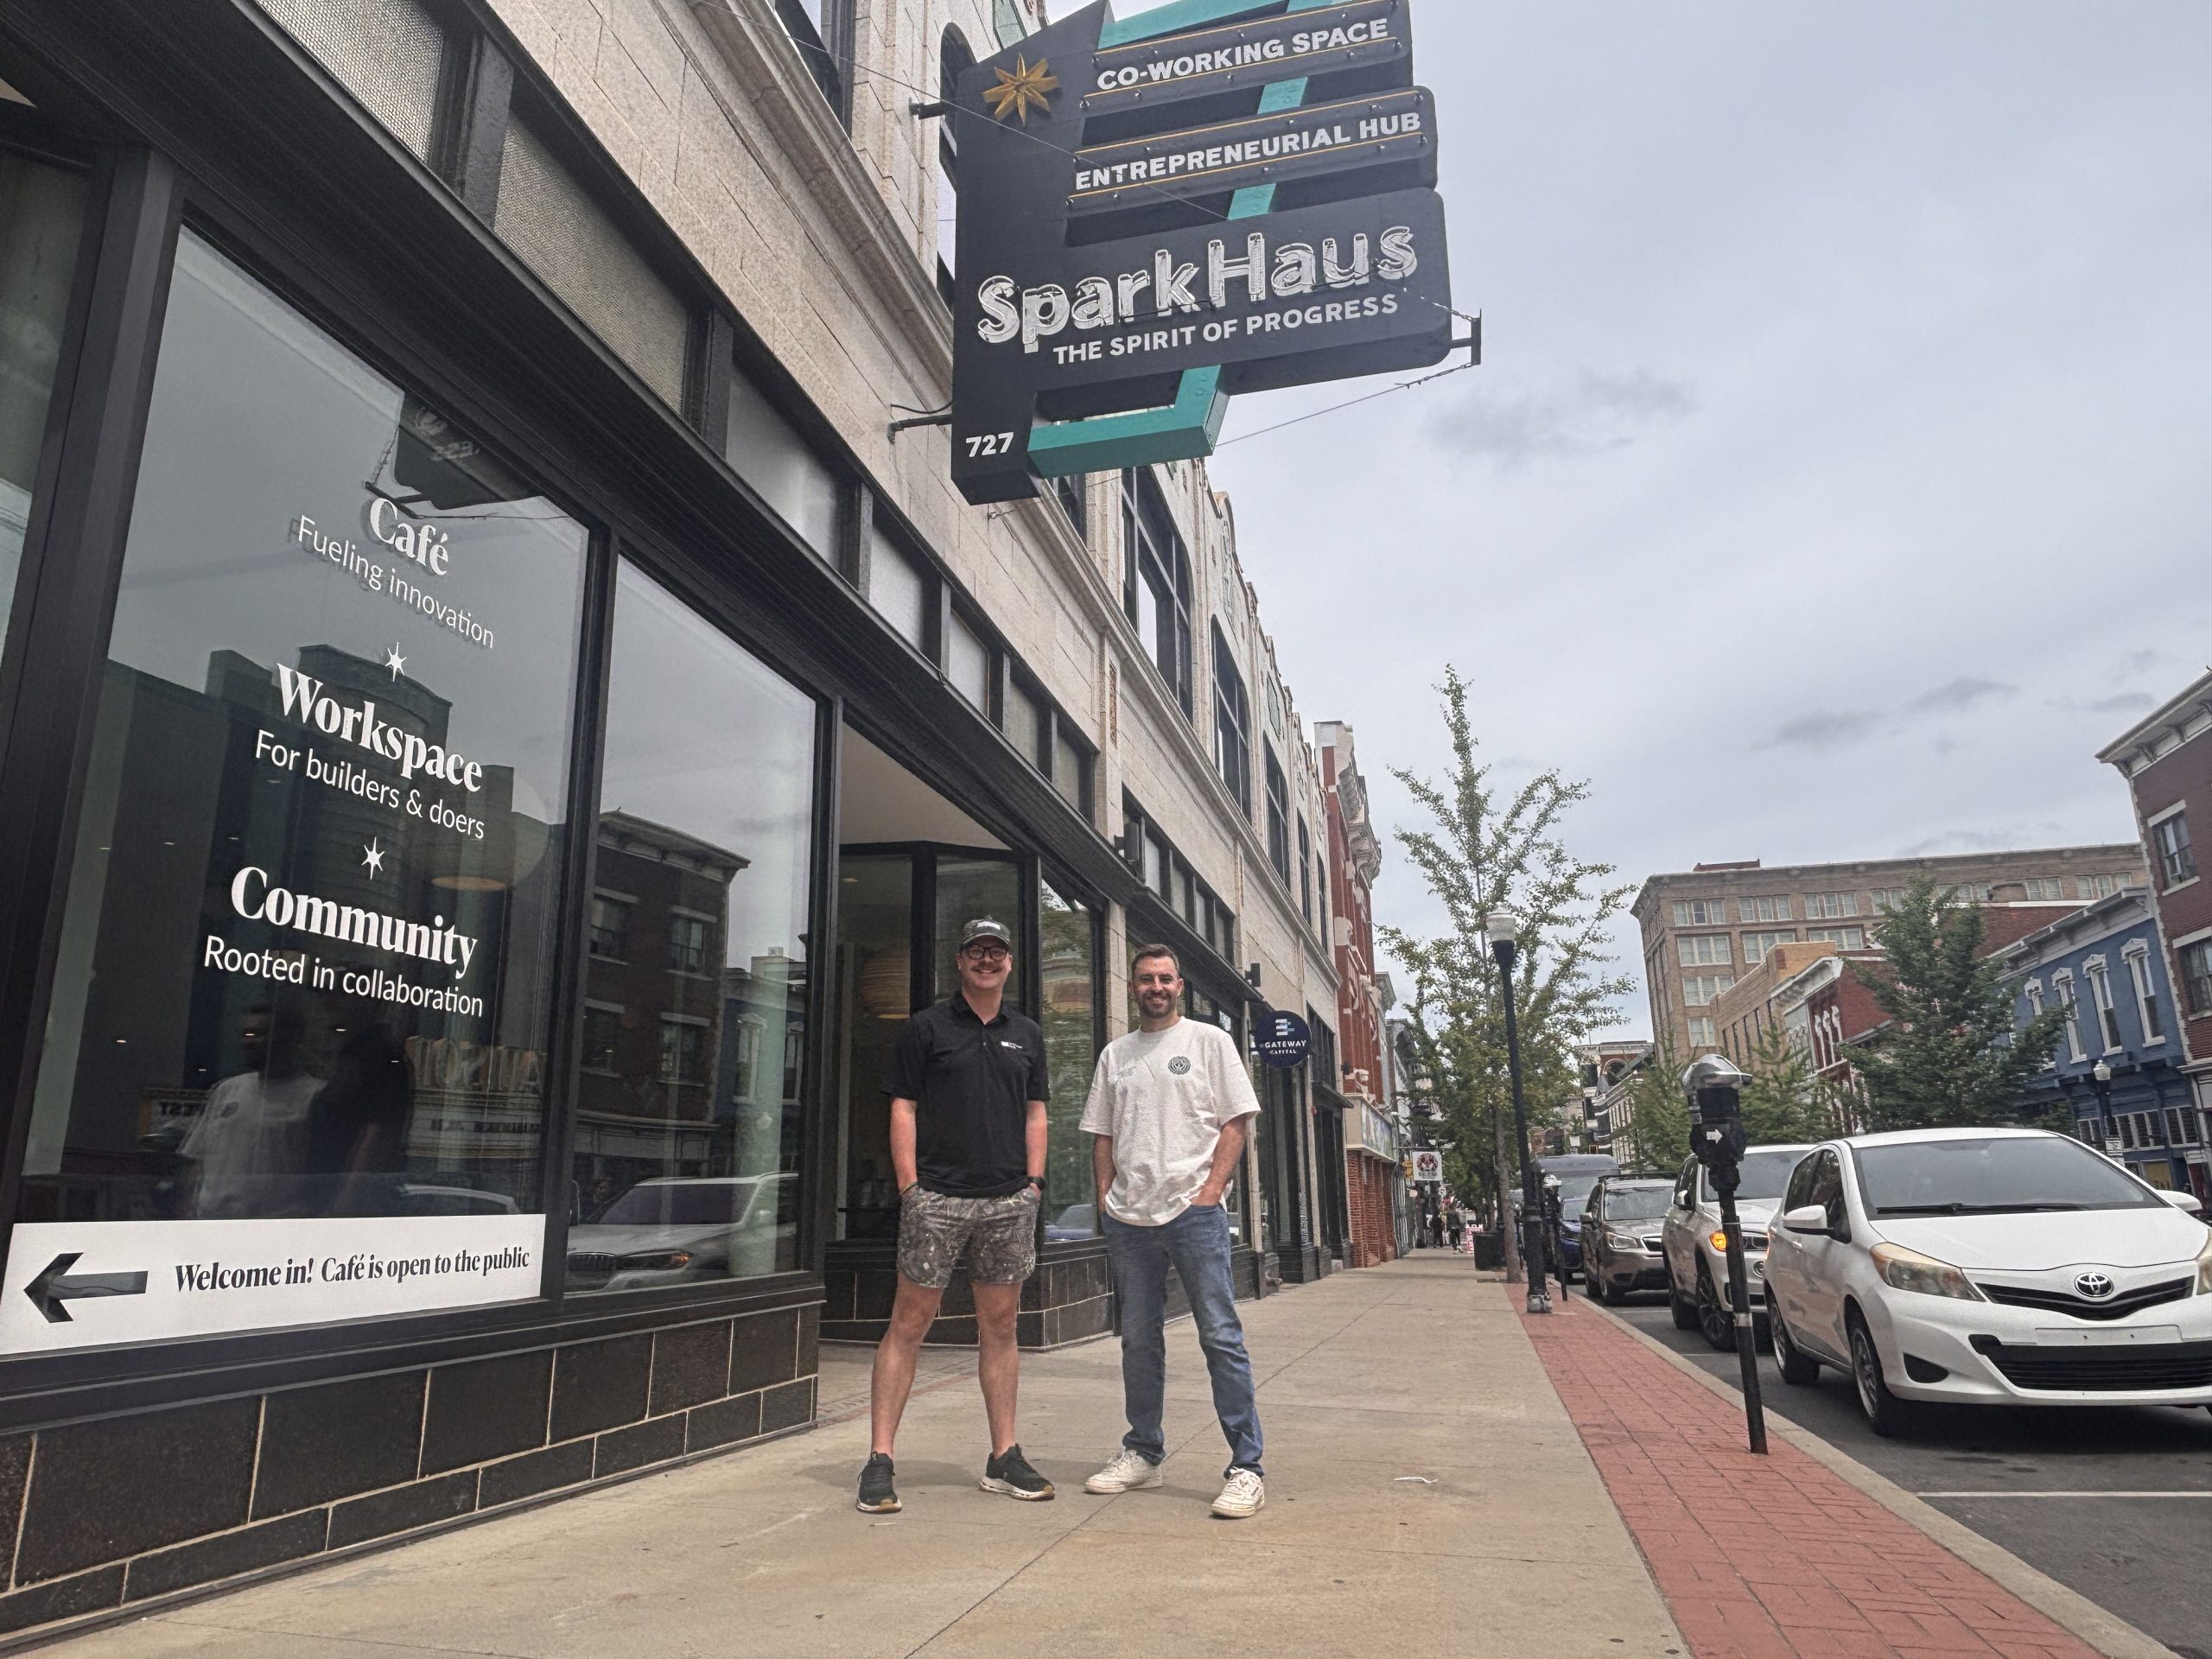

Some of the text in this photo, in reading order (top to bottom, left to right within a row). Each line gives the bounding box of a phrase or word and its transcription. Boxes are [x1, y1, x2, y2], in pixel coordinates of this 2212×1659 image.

[1096, 18, 1389, 91] CO-WORKING SPACE
[1075, 112, 1421, 190] ENTREPRENEURIAL HUB
[1053, 294, 1398, 365] THE SPIRIT OF PROGRESS
[965, 432, 1014, 458] 727
[370, 498, 448, 575] Café
[298, 516, 493, 649] Fueling innovation
[277, 664, 483, 792] Workspace
[256, 730, 485, 839] For builders & doers
[231, 867, 478, 979] Community
[205, 936, 483, 1017] Rooted in collaboration
[175, 1247, 530, 1292] Welcome in! Café is open to the public
